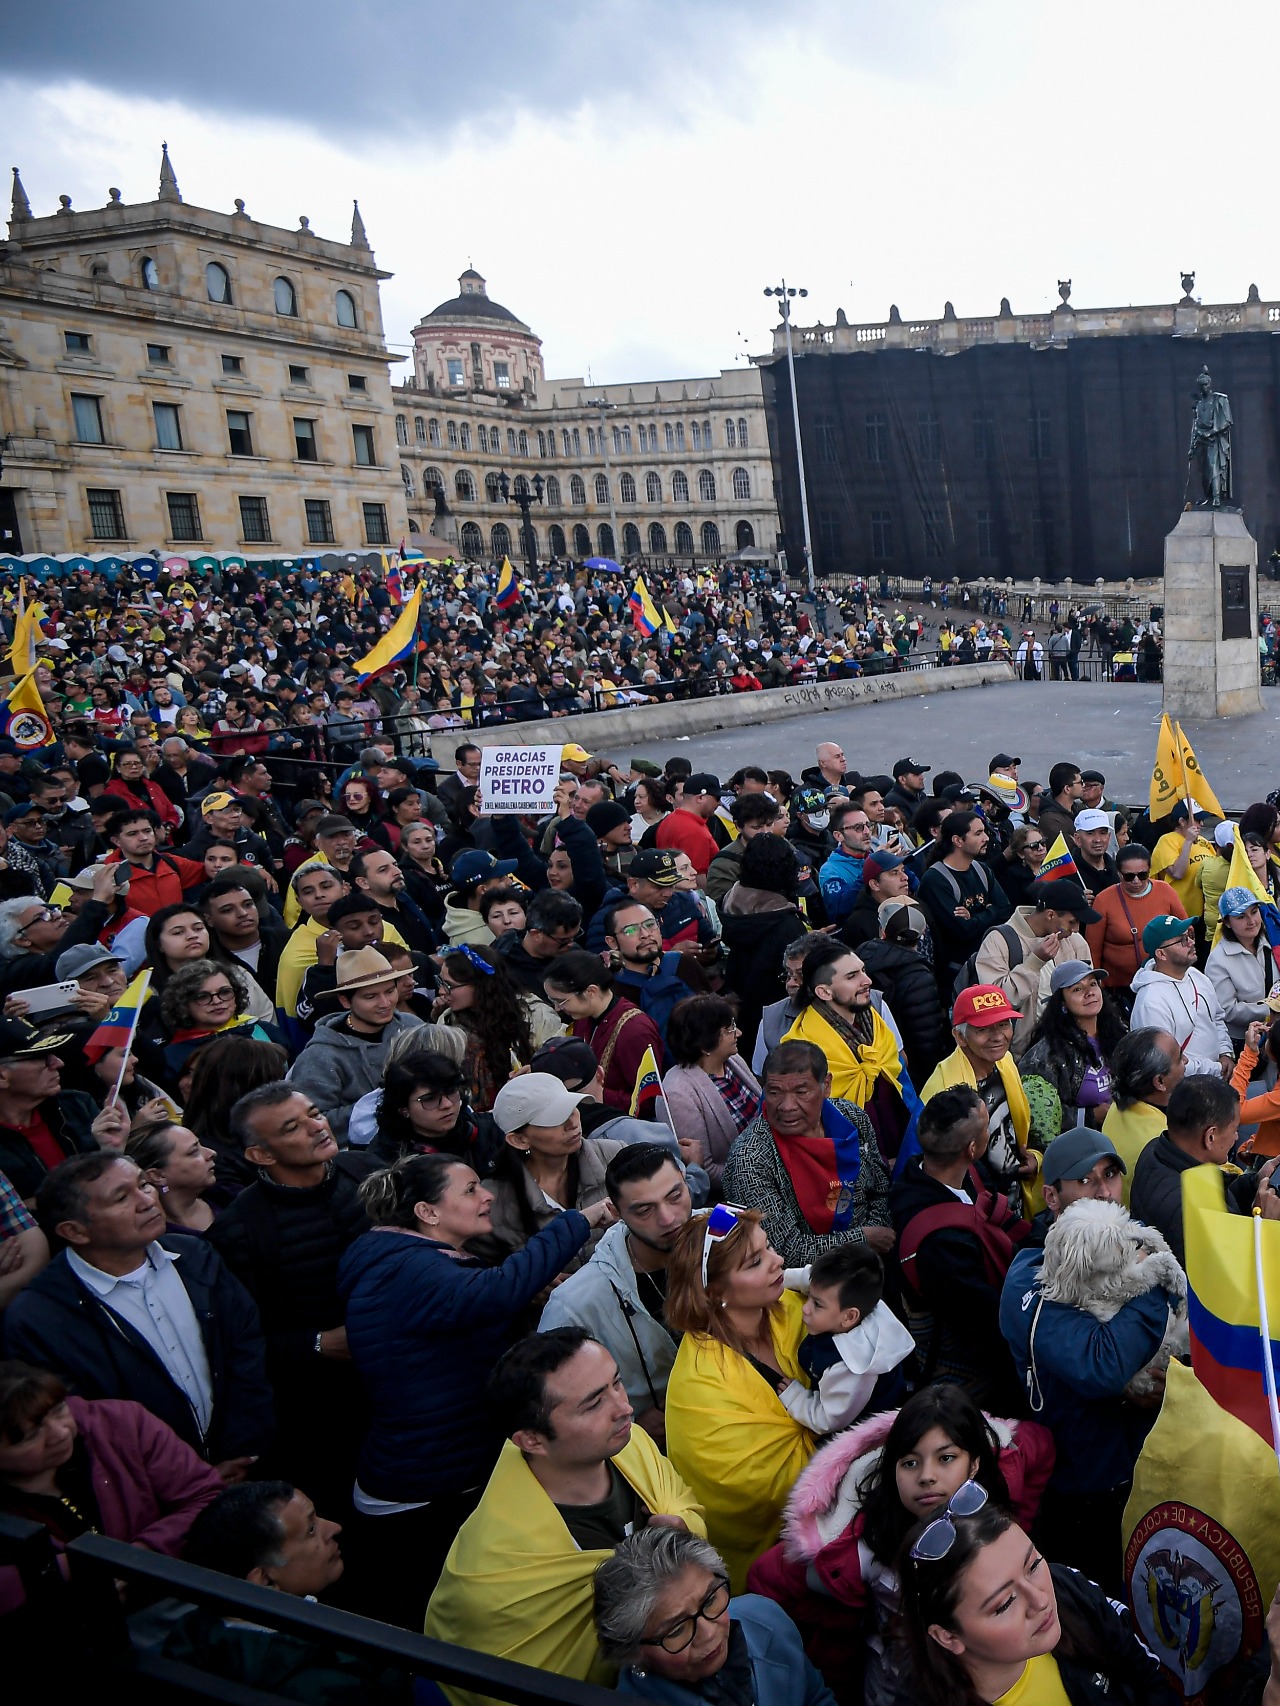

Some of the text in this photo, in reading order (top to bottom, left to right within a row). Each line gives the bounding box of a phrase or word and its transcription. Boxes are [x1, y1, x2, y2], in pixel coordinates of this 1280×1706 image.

[495, 751, 546, 763] GRACIAS
[484, 765, 555, 776] PRESIDENTE
[491, 778, 545, 795] PETRO
